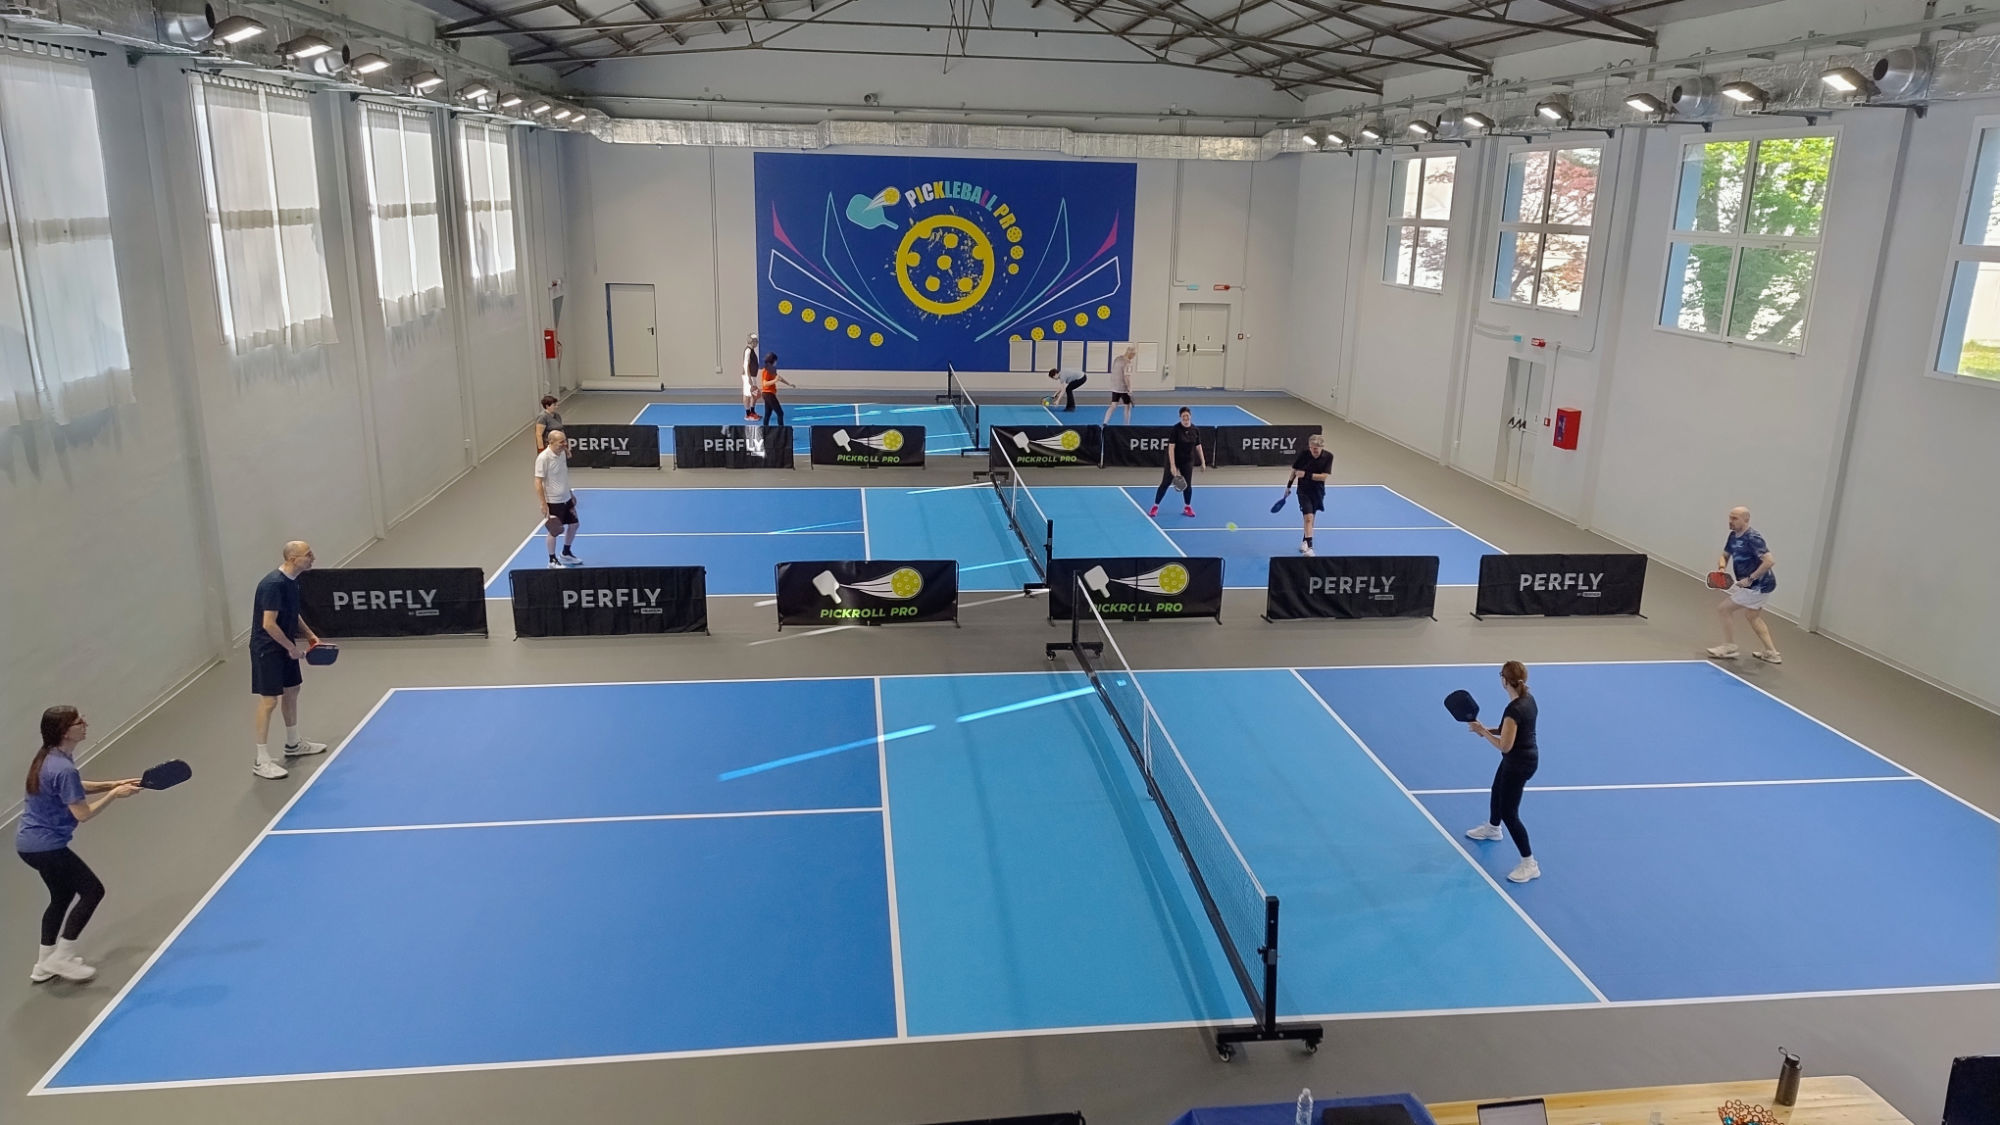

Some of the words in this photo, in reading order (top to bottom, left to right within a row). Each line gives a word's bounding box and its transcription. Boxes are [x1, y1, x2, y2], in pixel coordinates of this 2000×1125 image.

[905, 181, 998, 212] PICKLEBALL
[567, 437, 629, 451] PERFLY
[704, 438, 764, 452] PERFLY
[1130, 438, 1170, 451] PERF
[1242, 437, 1297, 450] PERFLY
[837, 454, 880, 463] PICKROLL
[882, 456, 900, 464] PRO
[1060, 455, 1077, 463] PRO
[1309, 576, 1396, 594] PERFLY
[1520, 573, 1604, 591] PERFLY
[333, 589, 437, 611] PERFLY
[562, 588, 661, 609] PERFLY
[820, 608, 886, 619] PICKROLL
[890, 606, 918, 617] PRO
[1156, 603, 1183, 613] PRO
